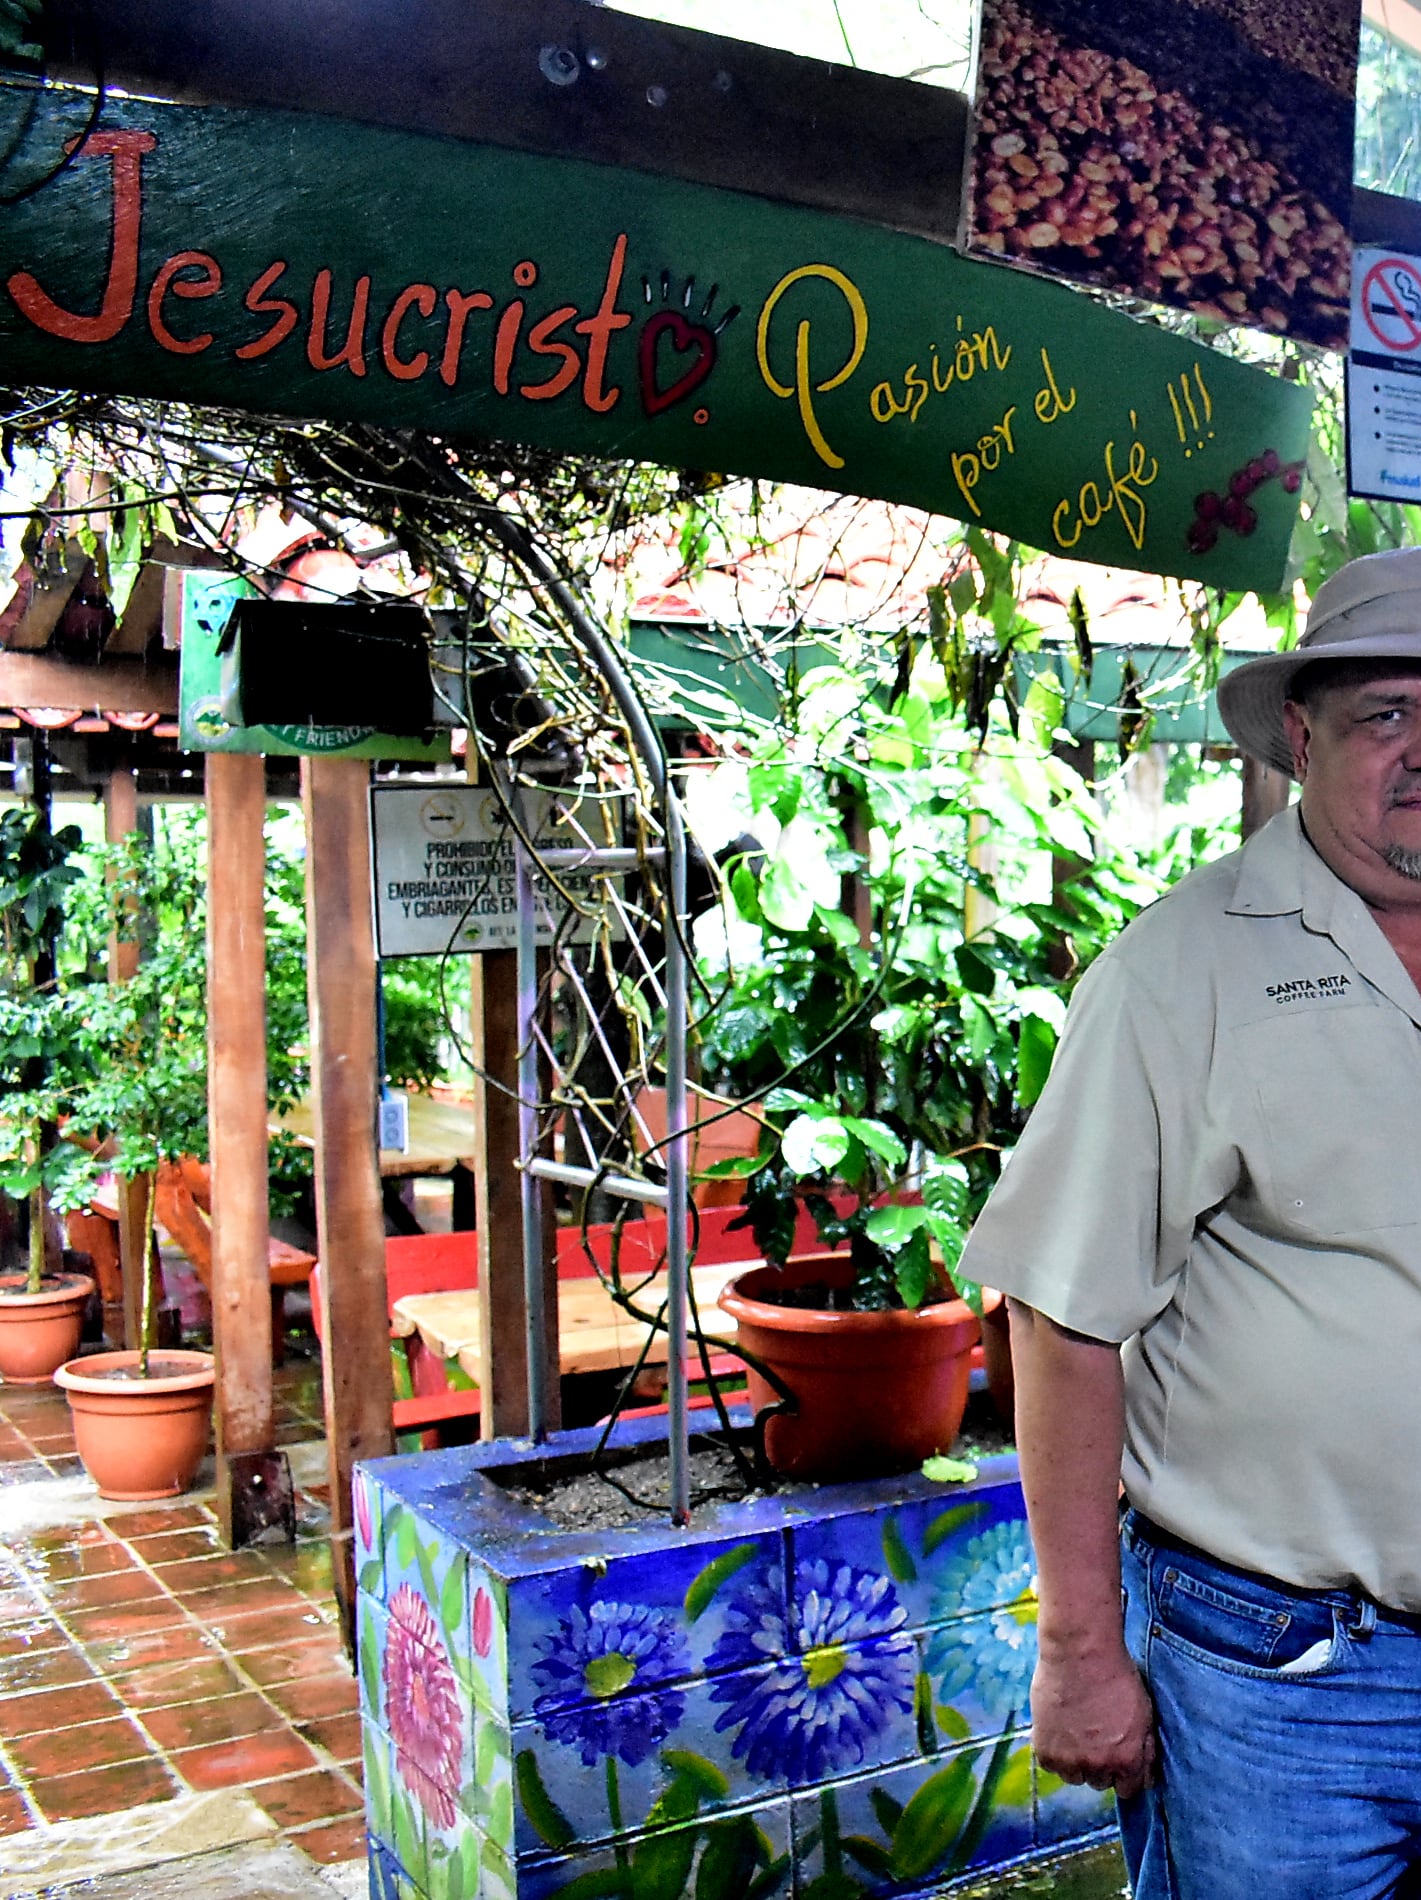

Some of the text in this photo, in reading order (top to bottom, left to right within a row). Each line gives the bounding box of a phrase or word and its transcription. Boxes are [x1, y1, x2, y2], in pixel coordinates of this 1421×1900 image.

[756, 262, 1012, 469] Pasión
[951, 347, 1077, 517] por el
[1052, 409, 1159, 550] café
[1265, 973, 1352, 998] SANTA RITA
[1276, 991, 1317, 1005] COFFEE
